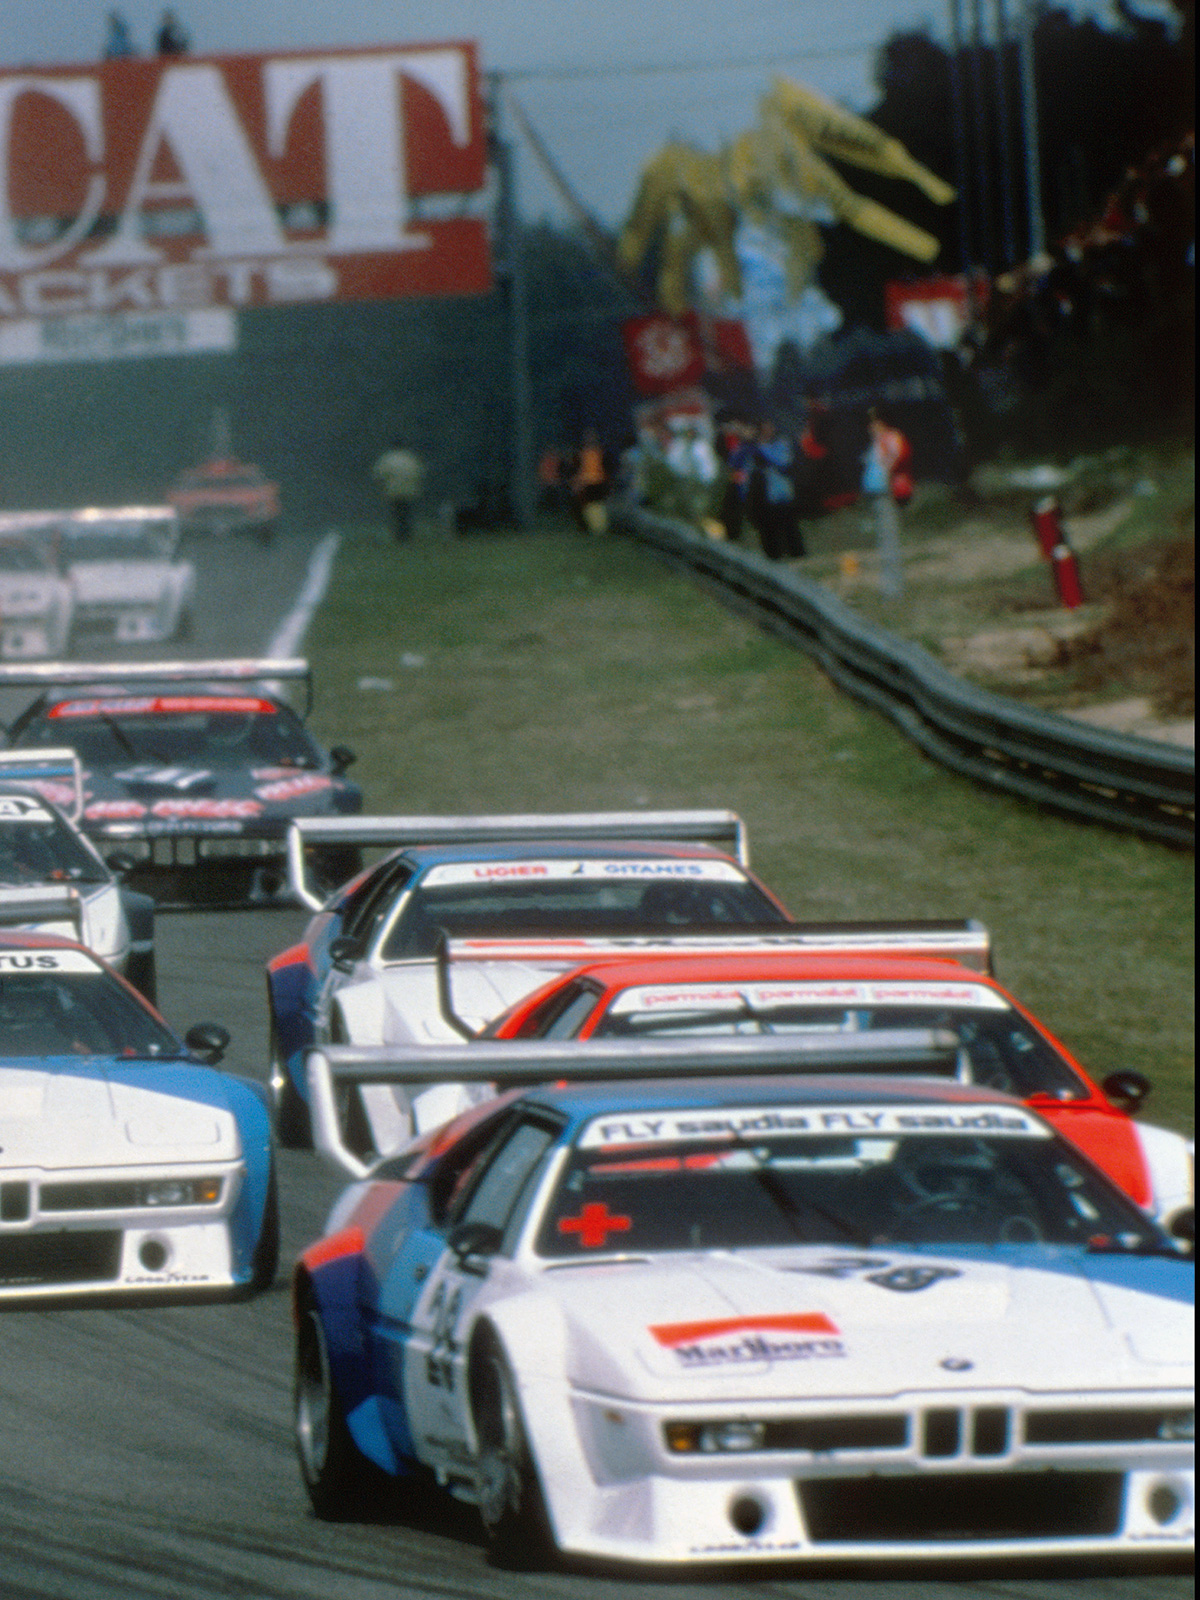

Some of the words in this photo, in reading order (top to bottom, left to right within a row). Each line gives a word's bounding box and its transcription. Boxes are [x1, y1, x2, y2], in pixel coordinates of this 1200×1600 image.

[474, 865, 548, 878] LIGIER
[604, 863, 702, 875] GITANES
[643, 990, 741, 1007] parmalat
[756, 987, 859, 1002] parmalat
[872, 988, 973, 1002] parmalat
[601, 1119, 664, 1141] FLY
[674, 1113, 809, 1133] saudia
[819, 1113, 886, 1130] FLY
[894, 1113, 1029, 1131] saudia
[673, 1336, 844, 1361] Marlboro
